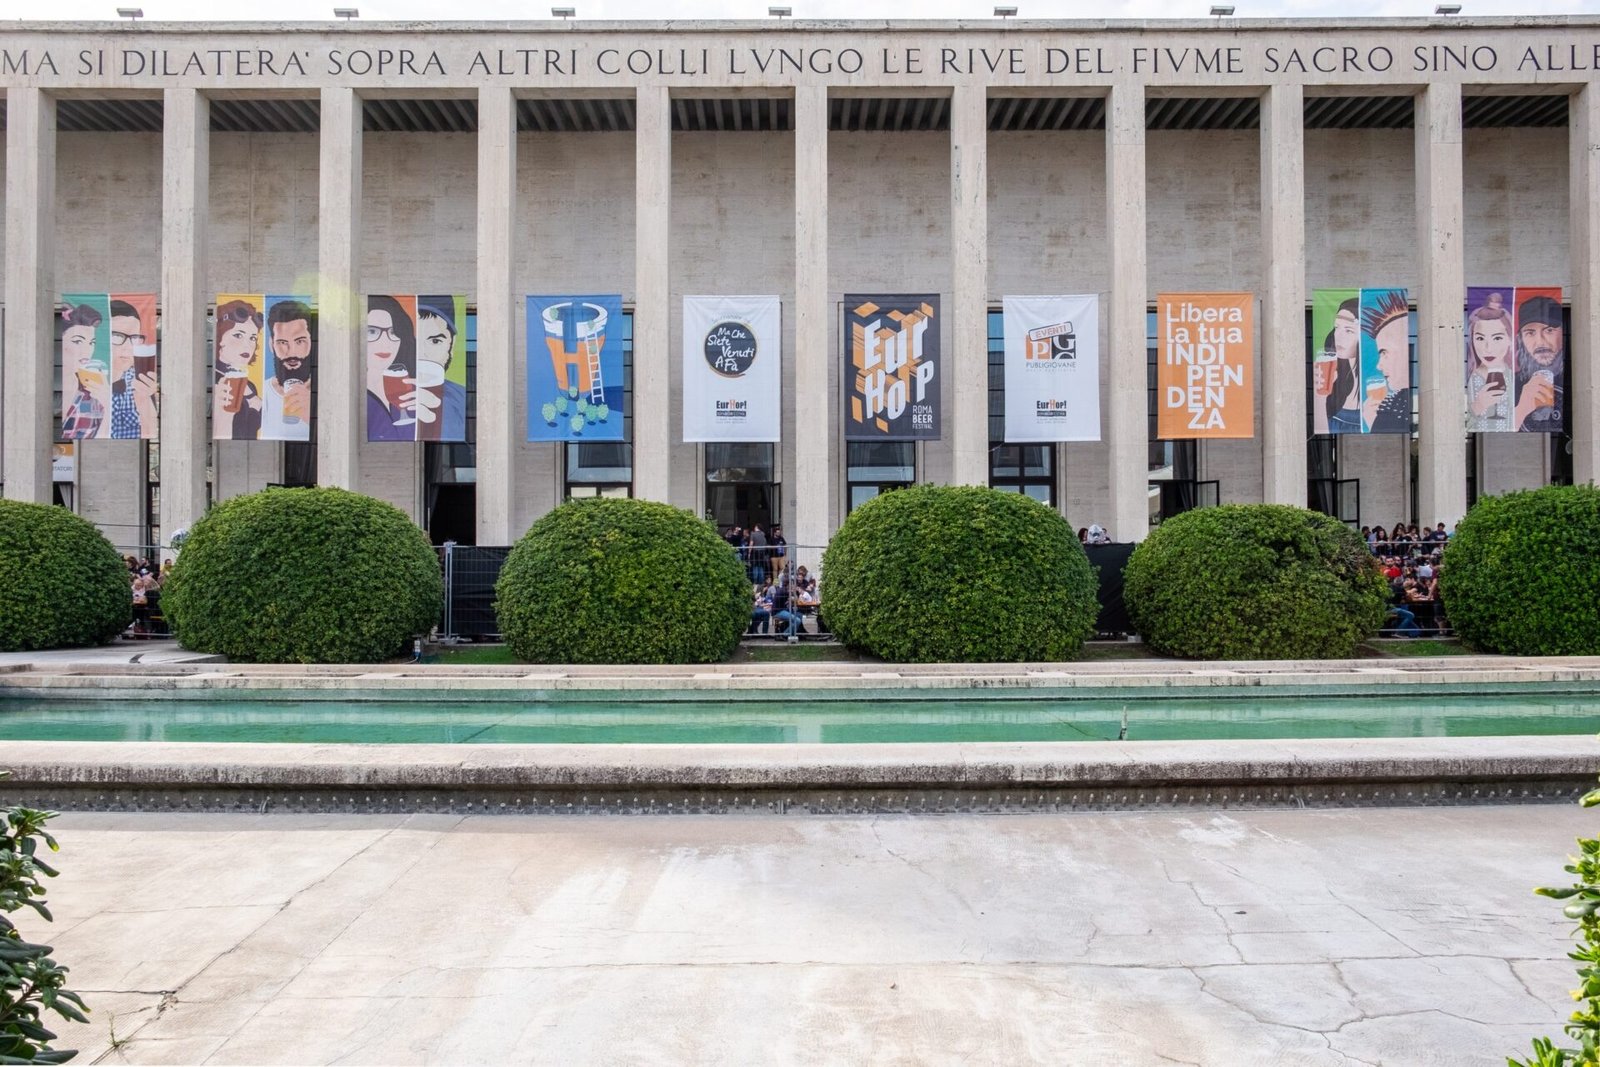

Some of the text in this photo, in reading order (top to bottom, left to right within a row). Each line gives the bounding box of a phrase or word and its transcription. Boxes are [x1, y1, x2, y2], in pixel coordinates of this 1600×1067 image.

[2, 49, 59, 76] MA
[78, 50, 104, 76] SI
[327, 50, 447, 76] SOPRA
[467, 49, 578, 75] ALTRI
[597, 49, 709, 75] COLLI
[730, 48, 863, 75] LVNGO
[882, 48, 923, 74] LE
[941, 48, 1026, 74] RIVE
[1045, 48, 1113, 74] DEL
[1132, 48, 1243, 74] FIVME
[1264, 47, 1393, 73] SACRO
[1413, 46, 1497, 72] SINO
[1166, 303, 1243, 322] Libera
[1035, 325, 1067, 339] EVENTI
[1166, 322, 1243, 343] la tua
[722, 346, 755, 357] Venuti
[1166, 343, 1225, 365] INDI
[1187, 364, 1243, 386] PEN
[1167, 386, 1225, 408] DEN
[912, 415, 933, 423] BEER
[913, 405, 933, 414] ROMA
[1187, 407, 1226, 430] ZA
